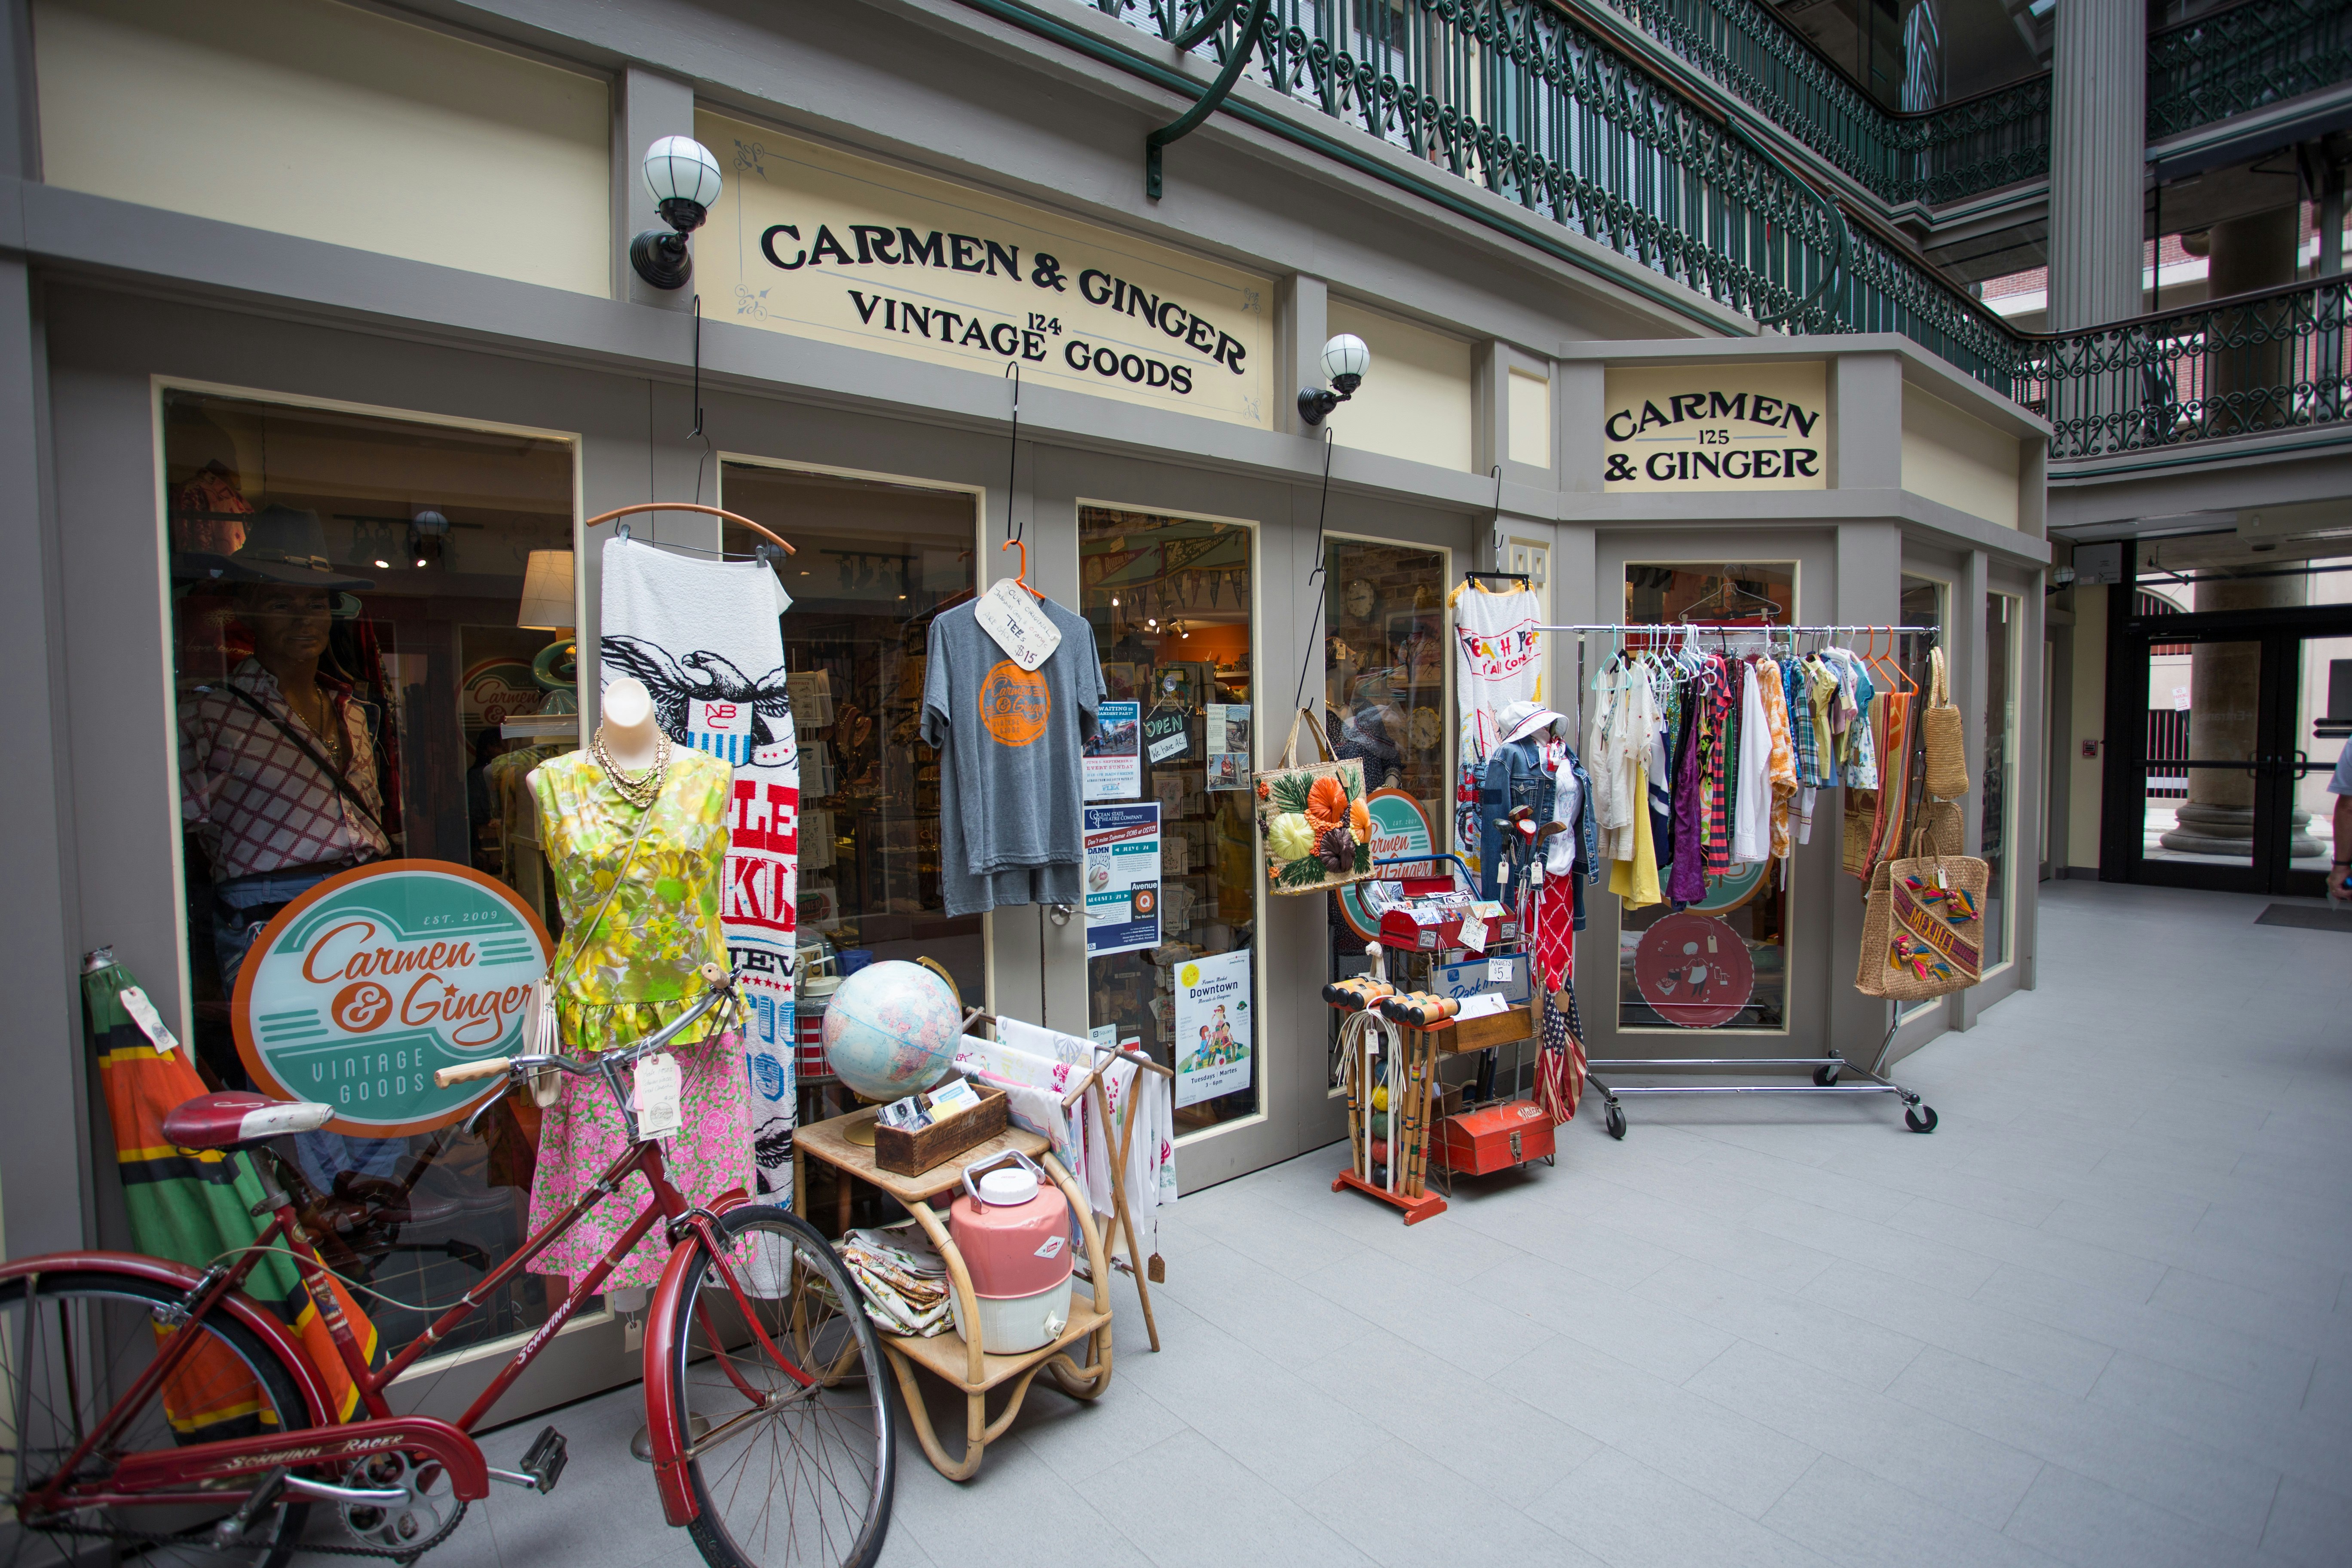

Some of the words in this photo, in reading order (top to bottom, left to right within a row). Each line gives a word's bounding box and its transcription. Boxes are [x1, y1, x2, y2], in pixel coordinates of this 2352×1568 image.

[761, 224, 1022, 270] CARMEN
[1032, 253, 1067, 292] &
[1079, 269, 1247, 375] GINGER
[1028, 312, 1062, 336] 124
[848, 290, 1047, 362] VINTAGE
[1065, 341, 1192, 395] GOODS
[1605, 392, 1819, 442] CARMEN
[1699, 429, 1730, 444] 125
[1604, 454, 1637, 481] &
[1645, 448, 1819, 481] GINGER
[1008, 589, 1022, 605] OUR
[1015, 644, 1038, 664] $15
[474, 680, 538, 704] Carmen
[991, 678, 1032, 698] Carmen
[1145, 714, 1182, 738] OPEN
[1152, 747, 1161, 759] We
[1160, 744, 1174, 754] have
[1175, 734, 1186, 747] AC!
[1142, 825, 1156, 833] OSTC!
[1087, 846, 1109, 854] DAMN
[1088, 853, 1110, 871] YANKEES
[1132, 882, 1158, 891] Avenue
[1140, 895, 1150, 908] Q
[424, 914, 454, 925] EST.
[462, 910, 498, 922] 2009
[1466, 914, 1487, 933] POSTCDS
[1466, 924, 1470, 933] $2
[302, 921, 475, 984] Carmen
[1494, 967, 1503, 980] $5
[1190, 981, 1238, 998] Downtown
[342, 986, 387, 1028] &
[400, 972, 532, 1046] Ginger
[312, 1047, 423, 1082] VINTAGE
[1191, 1073, 1215, 1084] Tuesdays
[1219, 1068, 1237, 1076] Martes
[340, 1073, 425, 1104] GOODS
[517, 1298, 571, 1365] SCHWINN
[228, 1446, 322, 1470] SCHWINN
[342, 1434, 404, 1453] RACER
